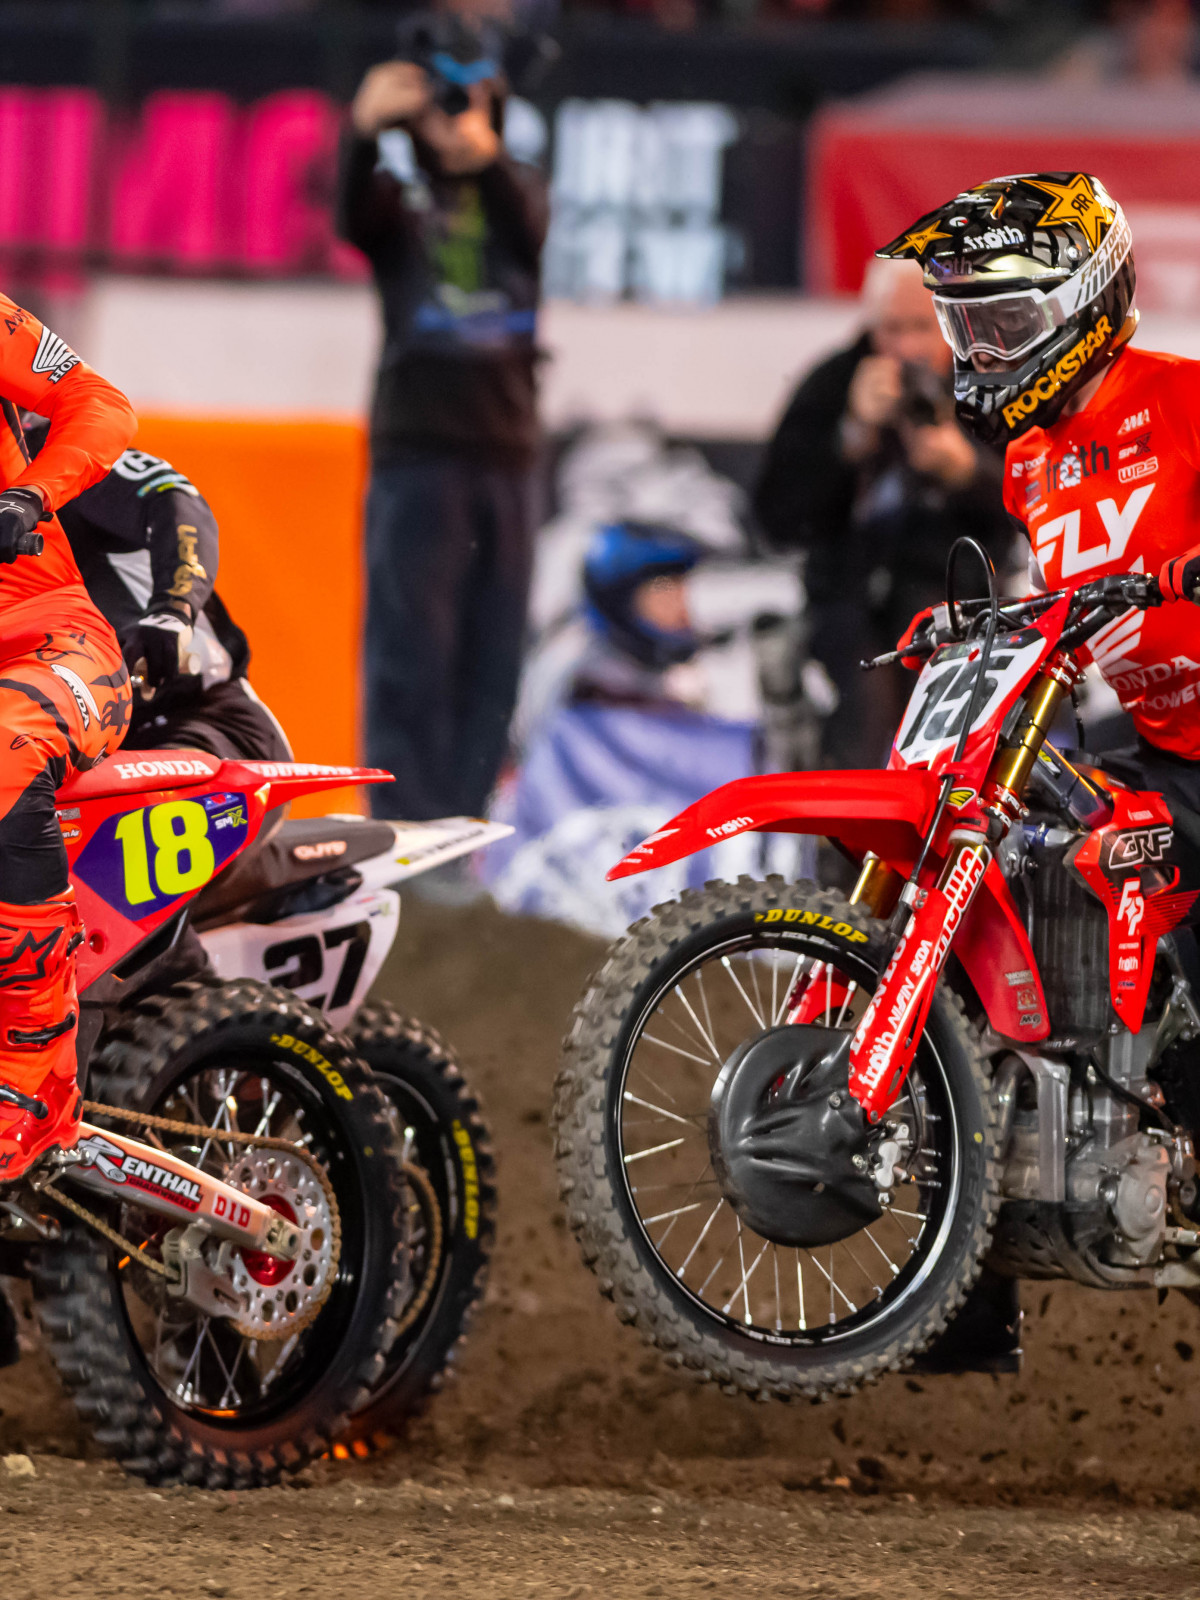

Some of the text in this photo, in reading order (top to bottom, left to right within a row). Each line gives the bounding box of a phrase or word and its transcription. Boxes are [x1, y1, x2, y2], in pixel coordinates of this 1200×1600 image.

[1001, 314, 1113, 430] ROCKSTAR
[1116, 408, 1151, 436] AMA
[1037, 483, 1156, 592] FLY
[899, 655, 1015, 752] 15
[113, 760, 214, 780] HONDA
[214, 809, 248, 830] SMX
[706, 816, 754, 838] froth
[115, 800, 216, 905] 18
[1108, 827, 1174, 869] CRF
[763, 908, 869, 943] DUNLOP
[263, 920, 373, 1015] 27
[276, 1034, 355, 1100] DUNLOP
[214, 1194, 251, 1229] DID
